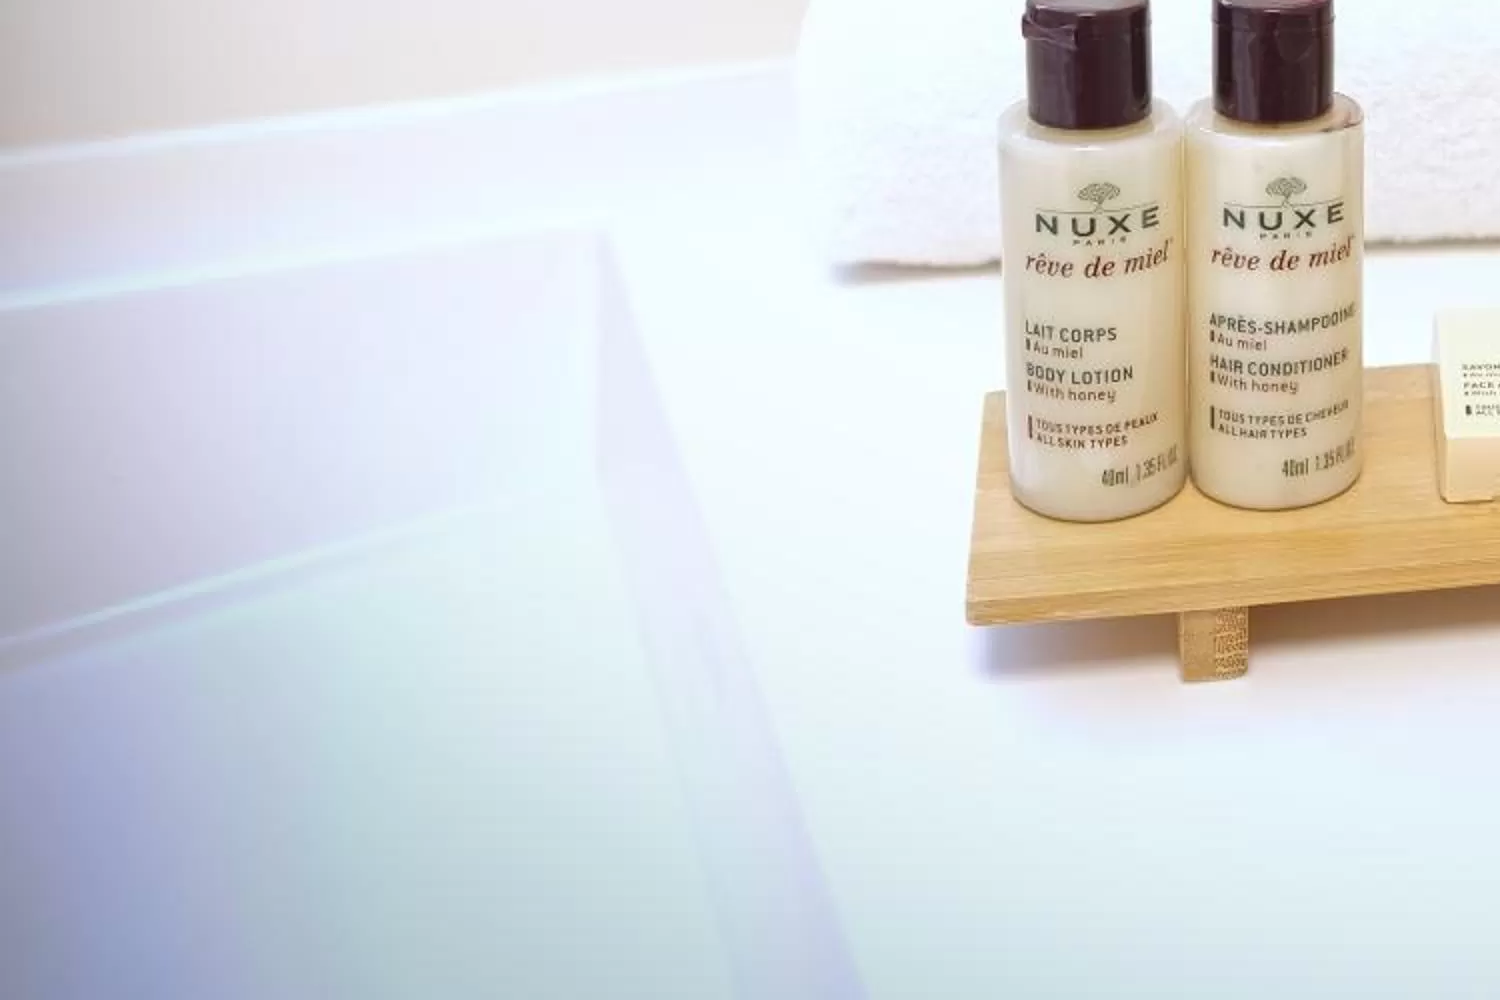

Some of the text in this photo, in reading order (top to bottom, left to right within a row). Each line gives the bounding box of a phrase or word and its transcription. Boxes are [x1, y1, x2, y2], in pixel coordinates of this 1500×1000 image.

[1035, 205, 1160, 237] NUXE
[1222, 202, 1344, 231] NUXE
[1025, 252, 1074, 278] rêve
[1083, 255, 1116, 279] de
[1211, 246, 1261, 271] rêve
[1269, 249, 1300, 272] de
[1025, 319, 1118, 343] LAIT CORPS
[1217, 332, 1267, 351] Au miel
[1033, 341, 1084, 359] Au miel
[1209, 347, 1349, 377] HAIR CONDITIONER
[1026, 362, 1134, 385] BODY LOTION
[1217, 373, 1298, 395] With honey
[1034, 381, 1117, 403] With honey
[1463, 381, 1495, 389] FACE
[1036, 411, 1159, 436] TOUS TYPES DE PEAUX
[1219, 408, 1245, 424] TOUS
[1249, 415, 1285, 426] TYPES
[1287, 413, 1302, 425] DE
[1036, 434, 1129, 449] ALL SKIN TYPES
[1218, 422, 1308, 439] ALL HAIR TYPES
